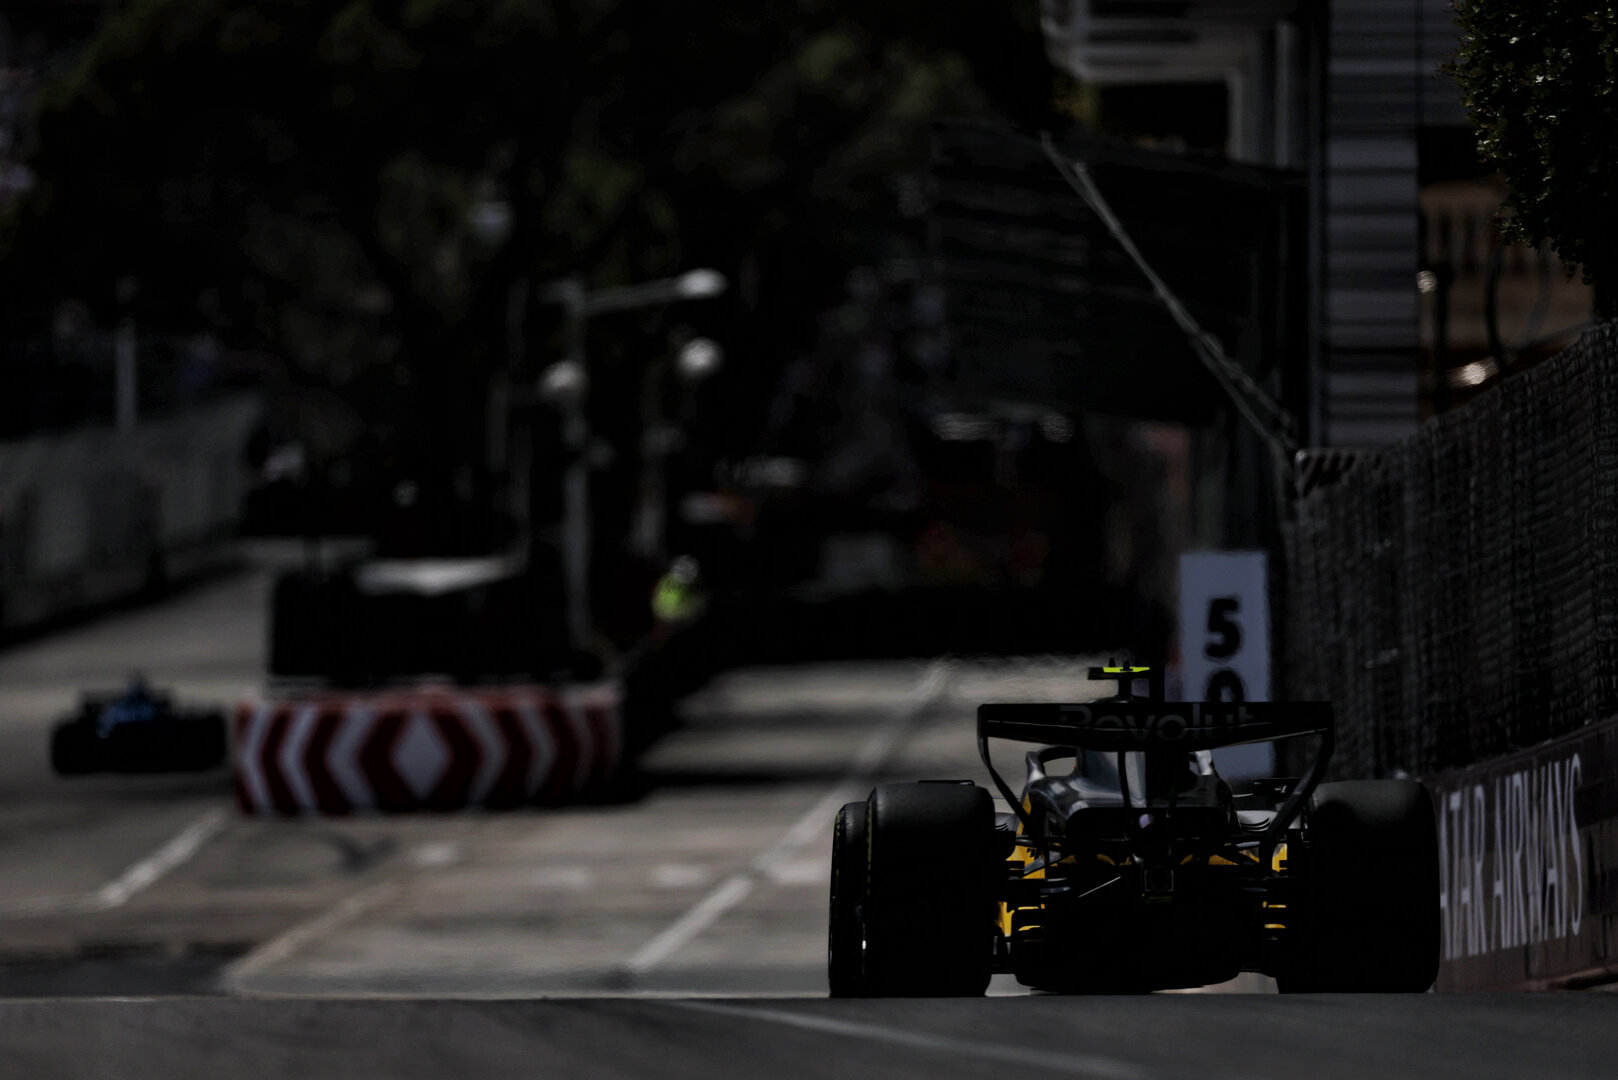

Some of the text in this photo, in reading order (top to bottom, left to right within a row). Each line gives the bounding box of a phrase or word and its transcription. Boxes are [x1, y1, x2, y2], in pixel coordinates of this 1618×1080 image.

[1060, 702, 1255, 742] Revolut
[1436, 752, 1583, 961] ATAR AIRWAYS
